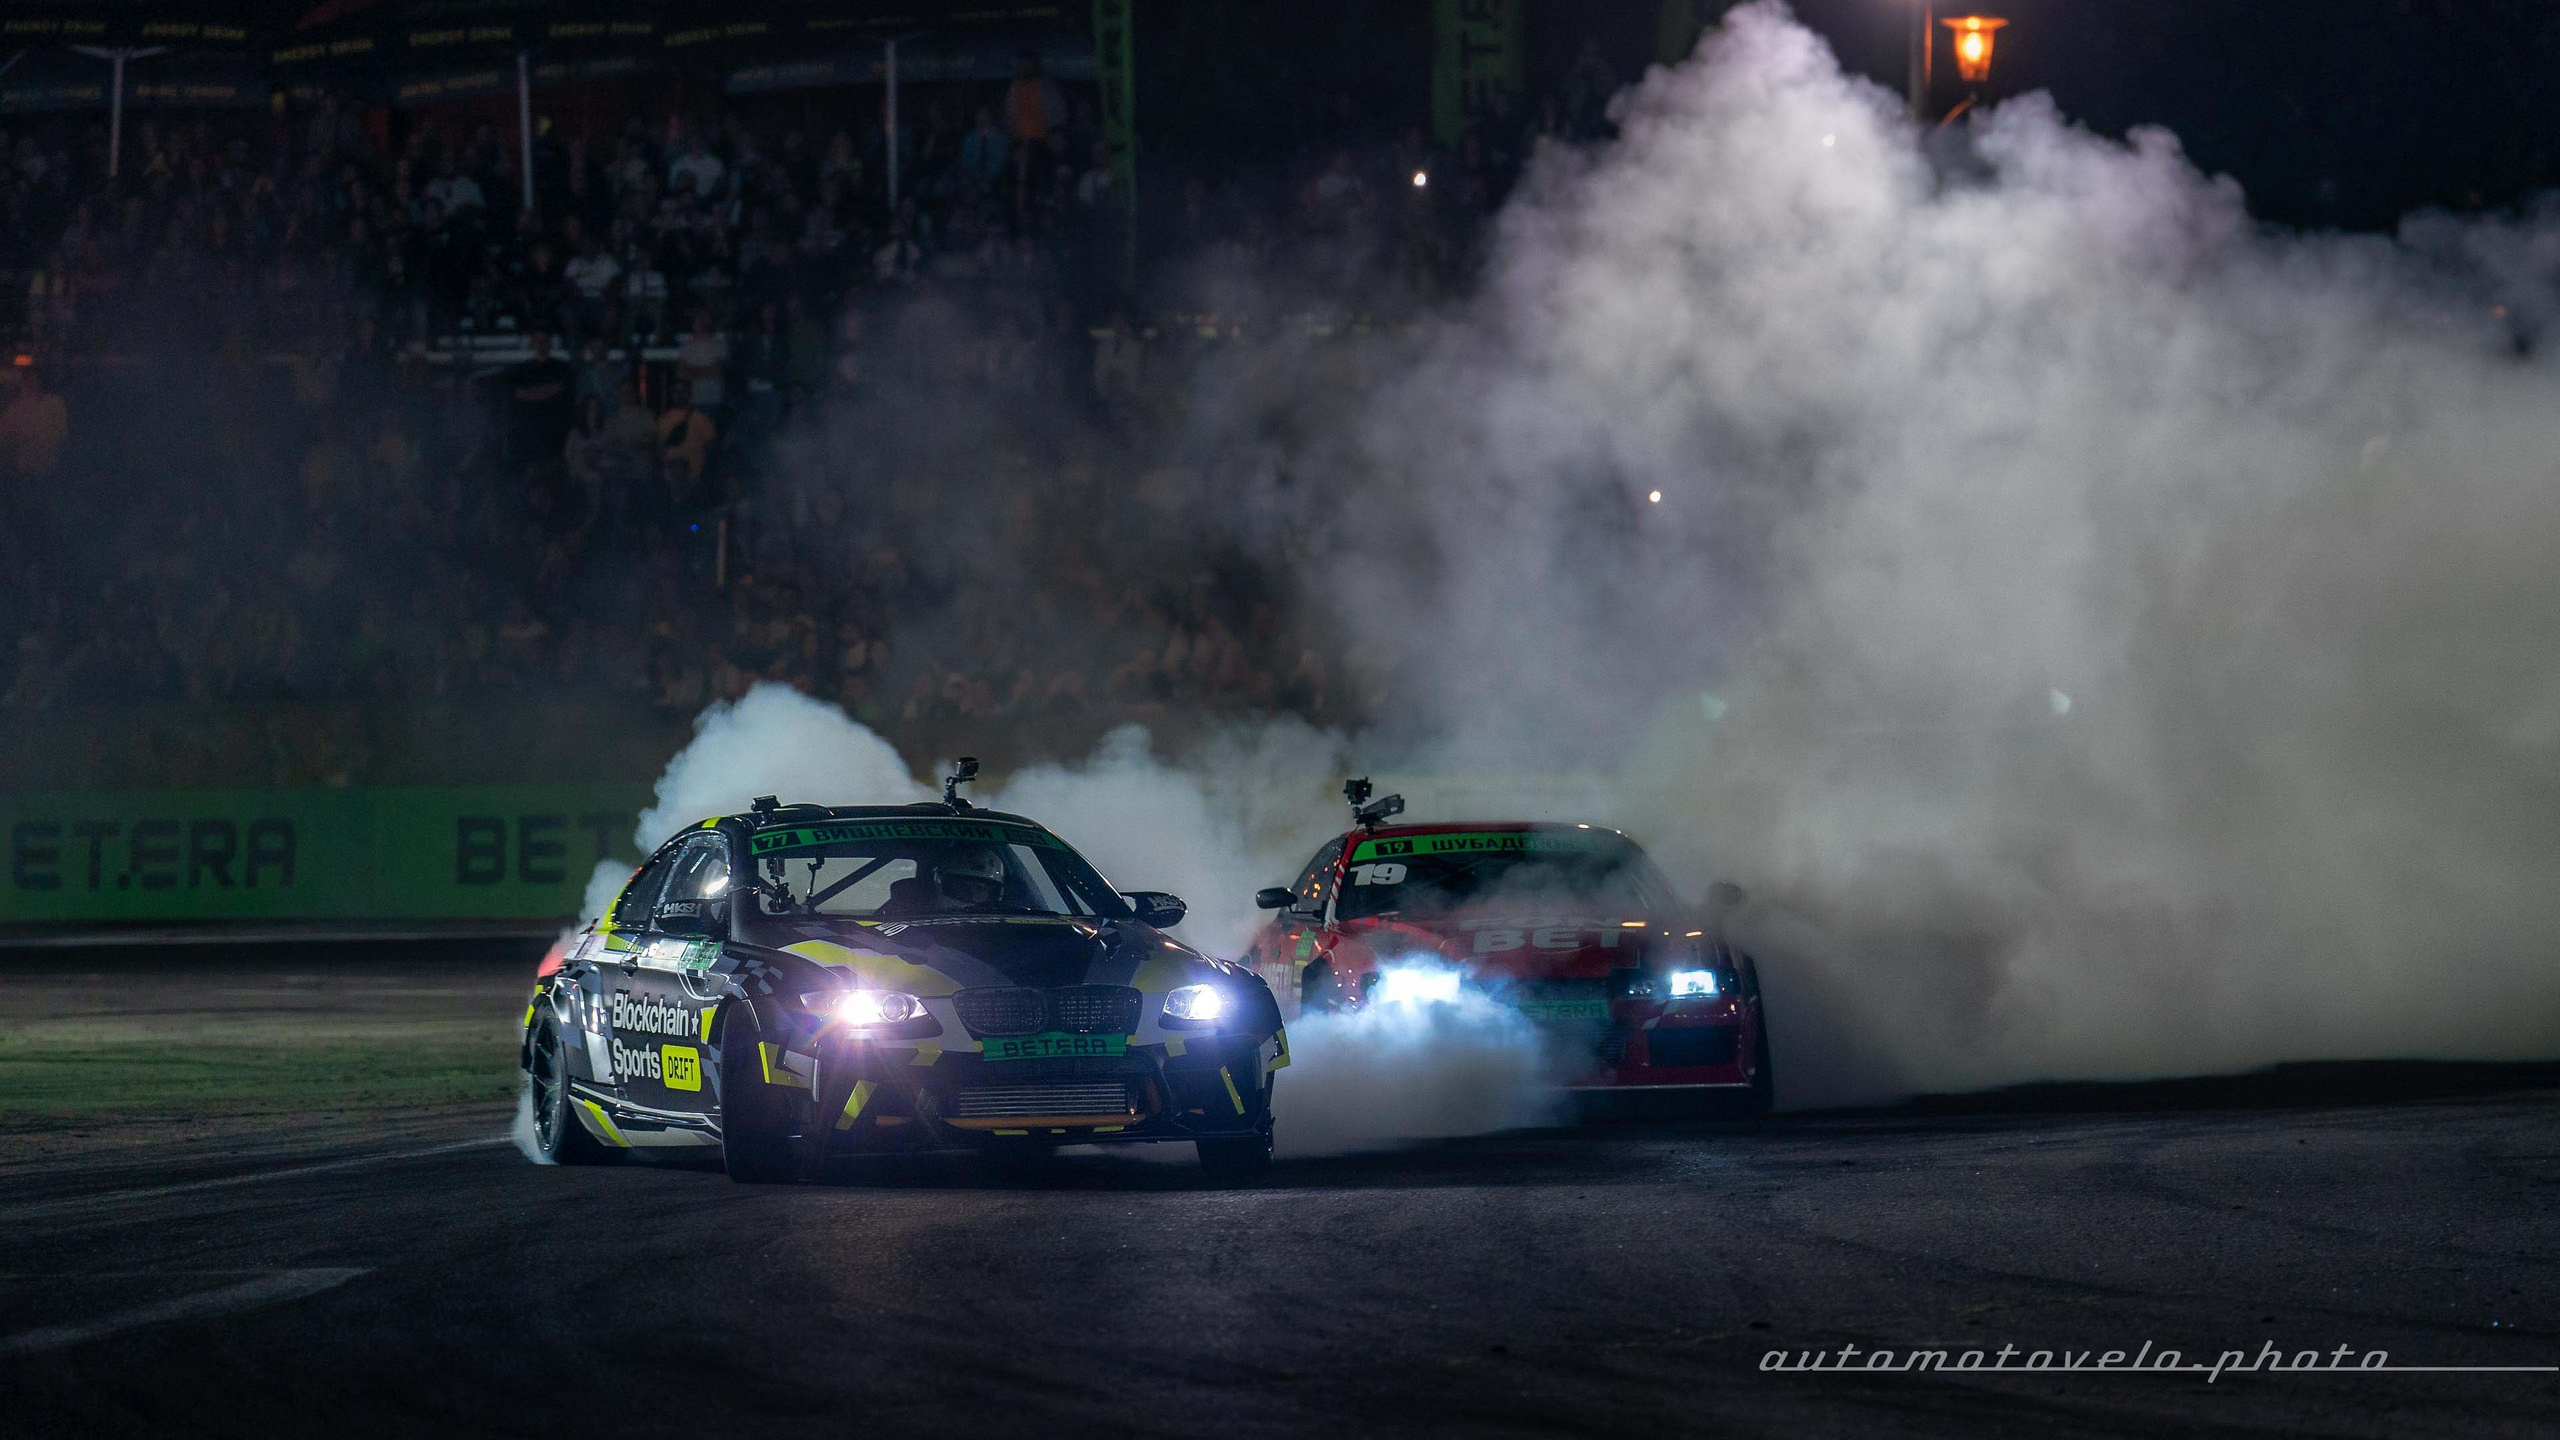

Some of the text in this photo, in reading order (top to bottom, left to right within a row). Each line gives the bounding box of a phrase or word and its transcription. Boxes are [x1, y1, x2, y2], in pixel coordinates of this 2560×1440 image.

[764, 834, 790, 849] 77
[1383, 841, 1406, 854] 19
[1349, 863, 1408, 886] 19
[612, 992, 689, 1037] Blockchain
[612, 1037, 661, 1083] Sports
[667, 1055, 695, 1081] DRIFT
